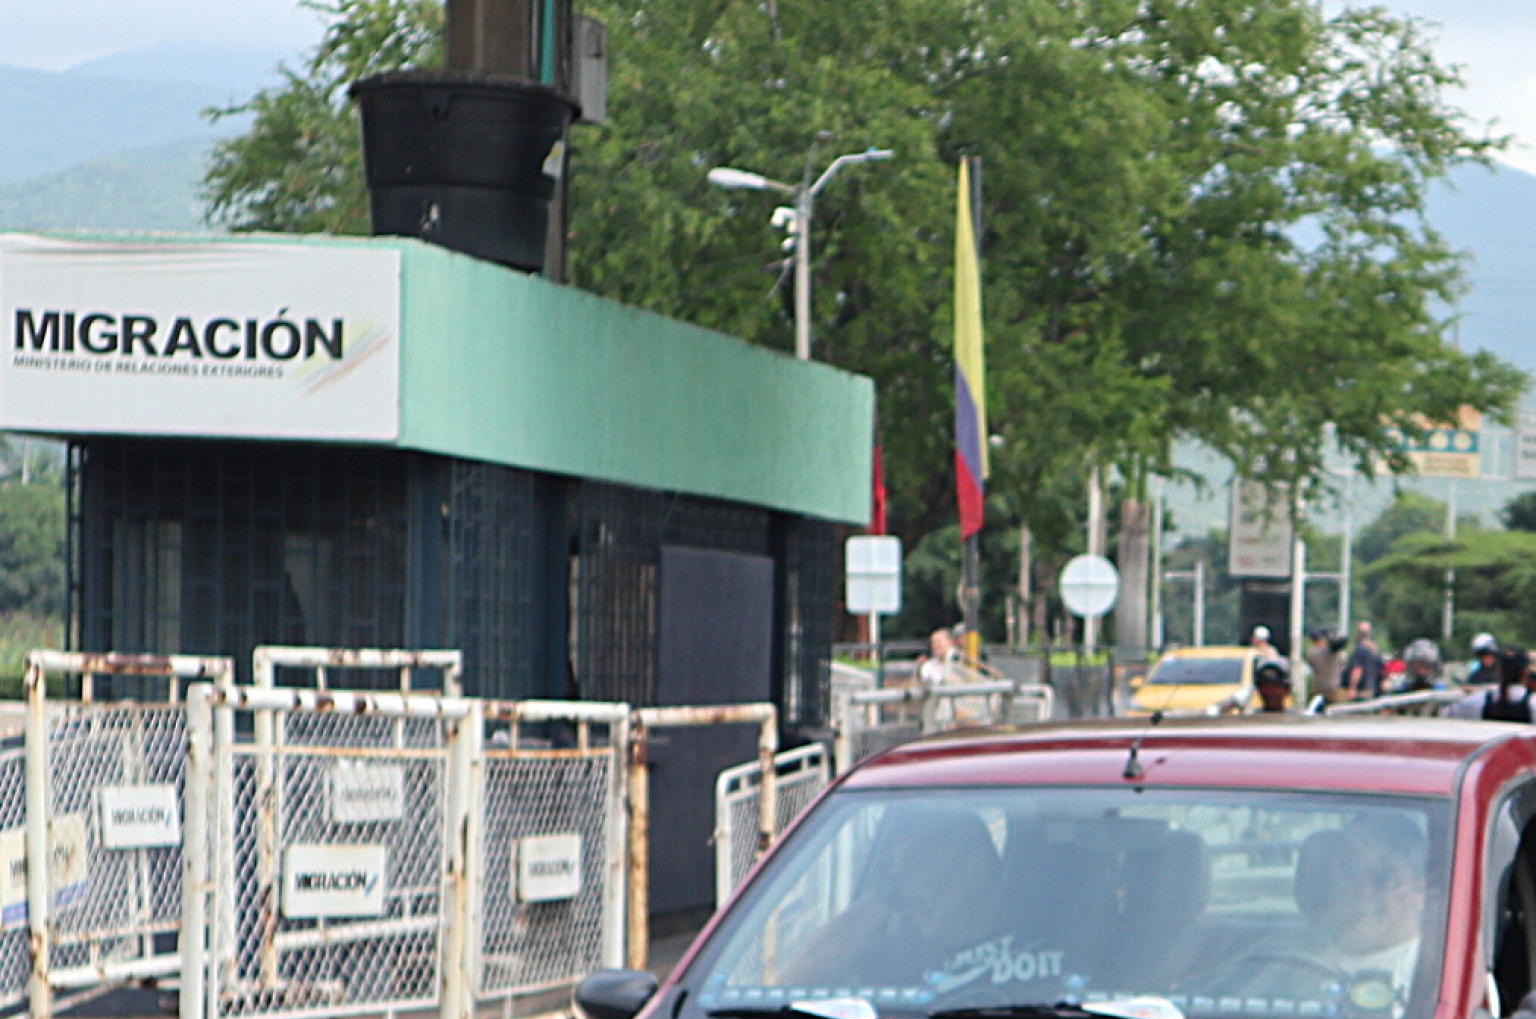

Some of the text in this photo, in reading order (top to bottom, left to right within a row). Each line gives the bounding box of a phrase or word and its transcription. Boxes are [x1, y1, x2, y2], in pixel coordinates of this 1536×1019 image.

[15, 305, 343, 360] MIGRACIÓN
[13, 356, 283, 378] MINISTERIO DE RELACIONES EXTERIORES
